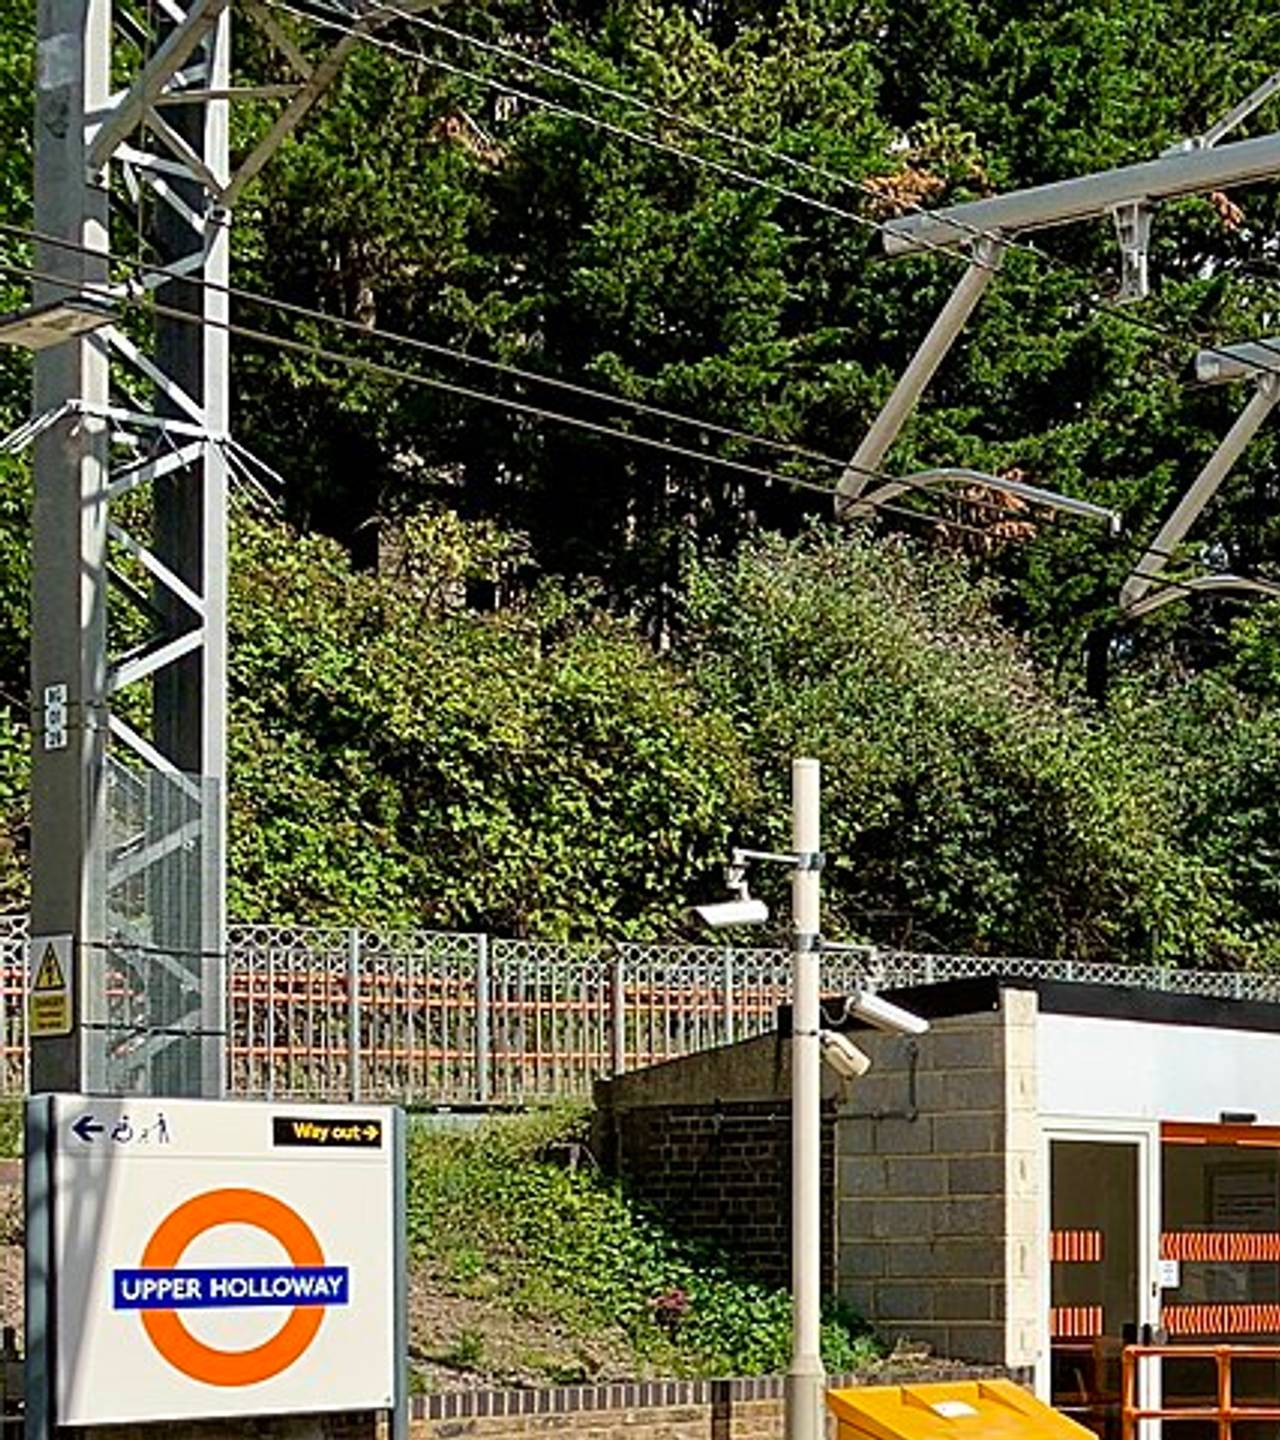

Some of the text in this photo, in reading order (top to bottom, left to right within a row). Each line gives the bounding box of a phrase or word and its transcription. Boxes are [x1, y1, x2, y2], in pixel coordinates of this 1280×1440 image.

[293, 1122, 361, 1143] Way out
[122, 1275, 343, 1300] UPPER HOLLOWAY
